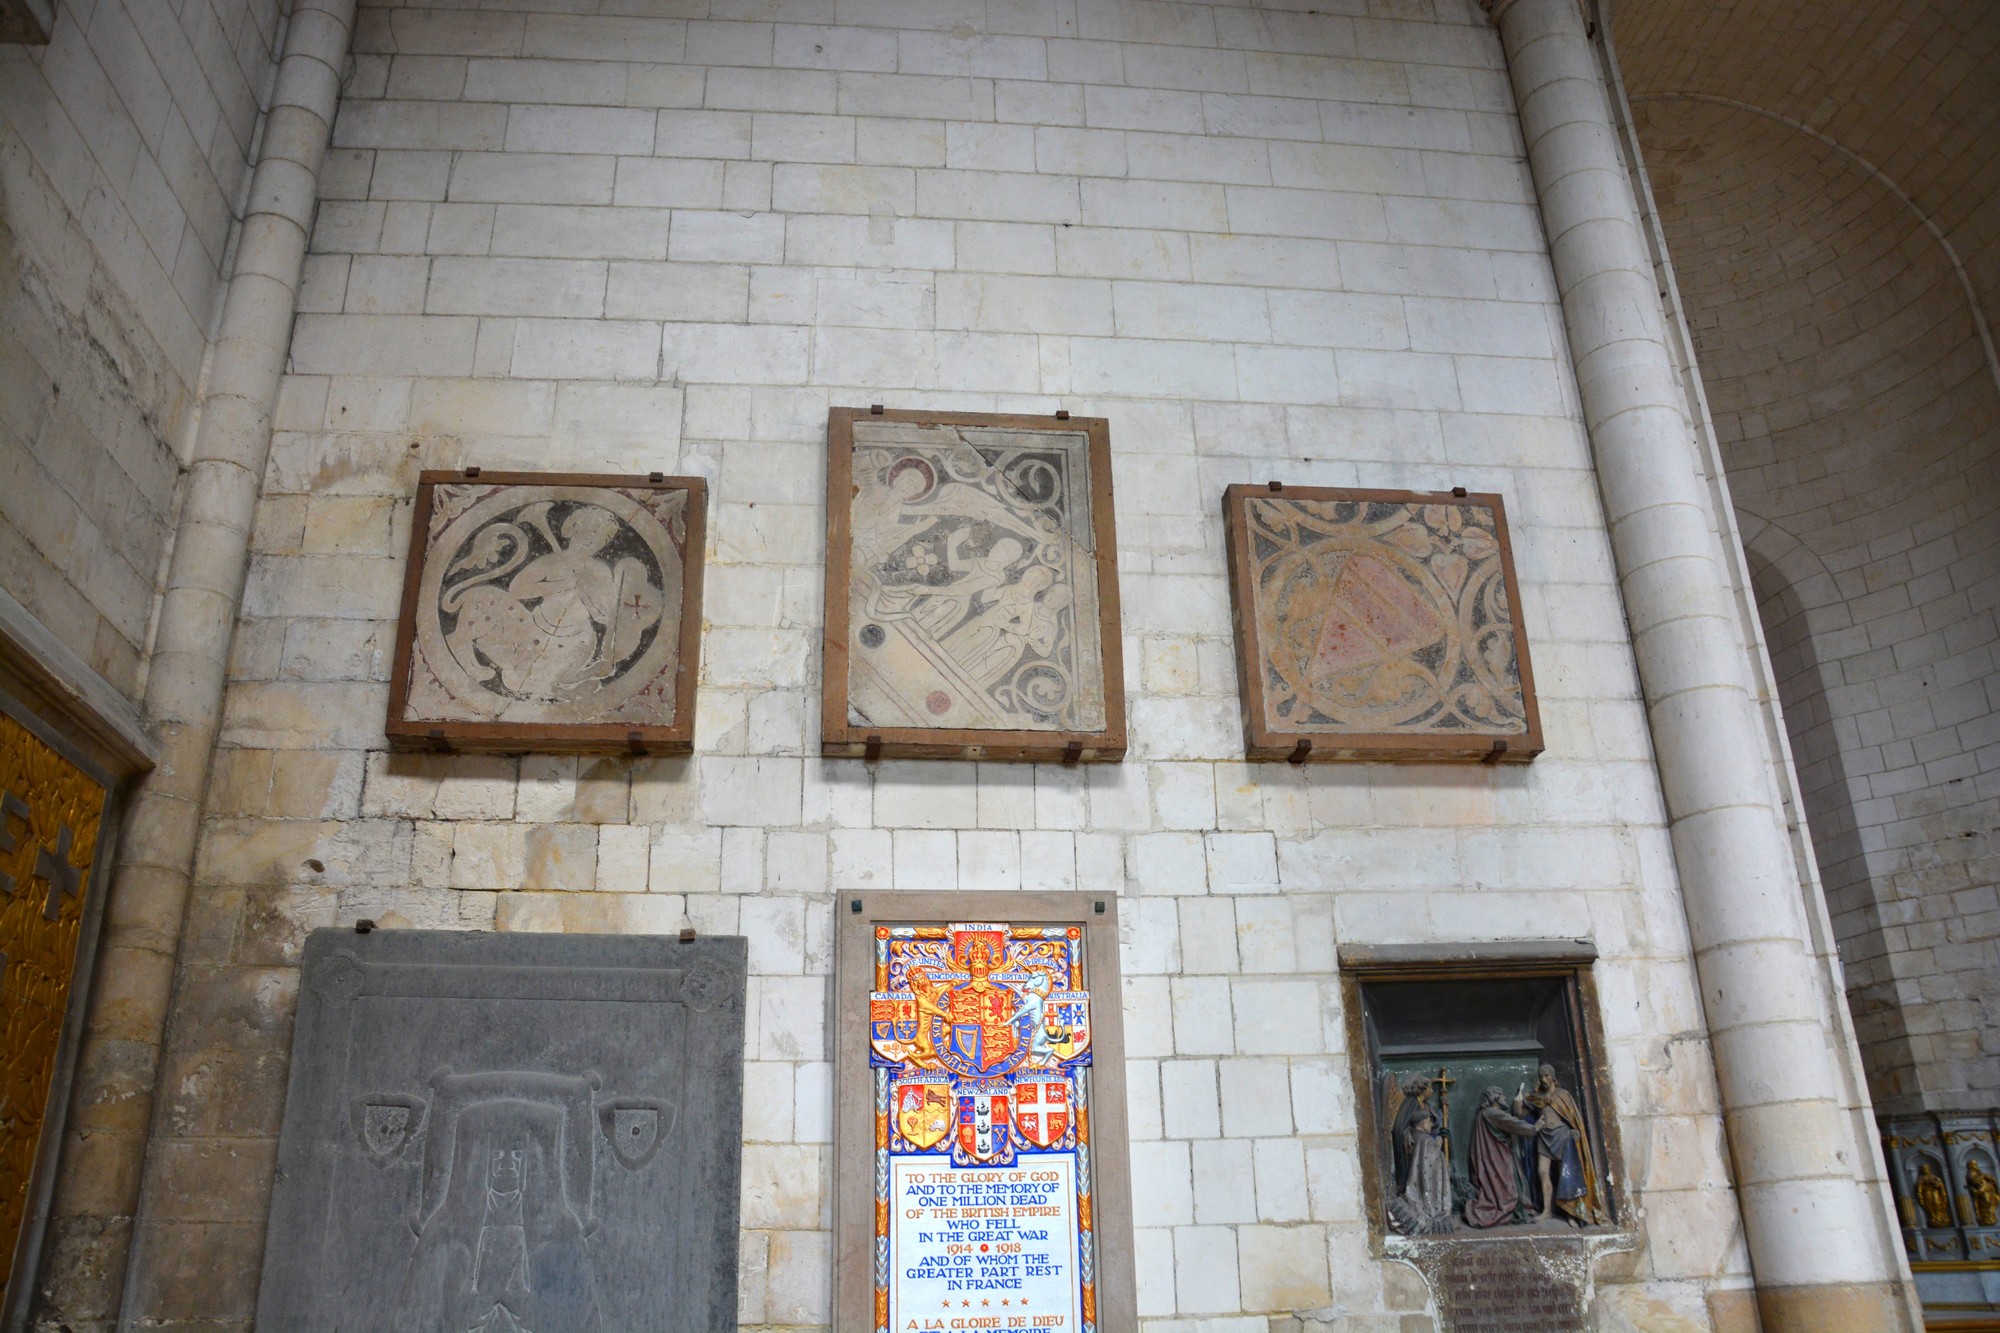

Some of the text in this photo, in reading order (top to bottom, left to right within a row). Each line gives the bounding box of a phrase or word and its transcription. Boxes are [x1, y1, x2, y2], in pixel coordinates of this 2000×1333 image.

[920, 958, 946, 968] UNITED
[906, 1172, 1059, 1183] TO THE GLORY OF GOD
[906, 1183, 1060, 1195] AND TO THE MEMORY OF
[918, 1195, 1047, 1206] ONE MILLION DEAD
[906, 1206, 1060, 1219] OF THE BRITISH EMPIRE
[946, 1219, 1020, 1230] WHO FELL
[919, 1230, 1048, 1242] IN THE GREAT WAR
[946, 1243, 1021, 1255] 1914 1918
[919, 1254, 1049, 1267] AND OF WHOM THE
[906, 1266, 1062, 1278] GREATER PART REST
[948, 1279, 1022, 1290] IN FRANCE
[906, 1315, 1064, 1329] A LA GLOIRE DE DIEU
